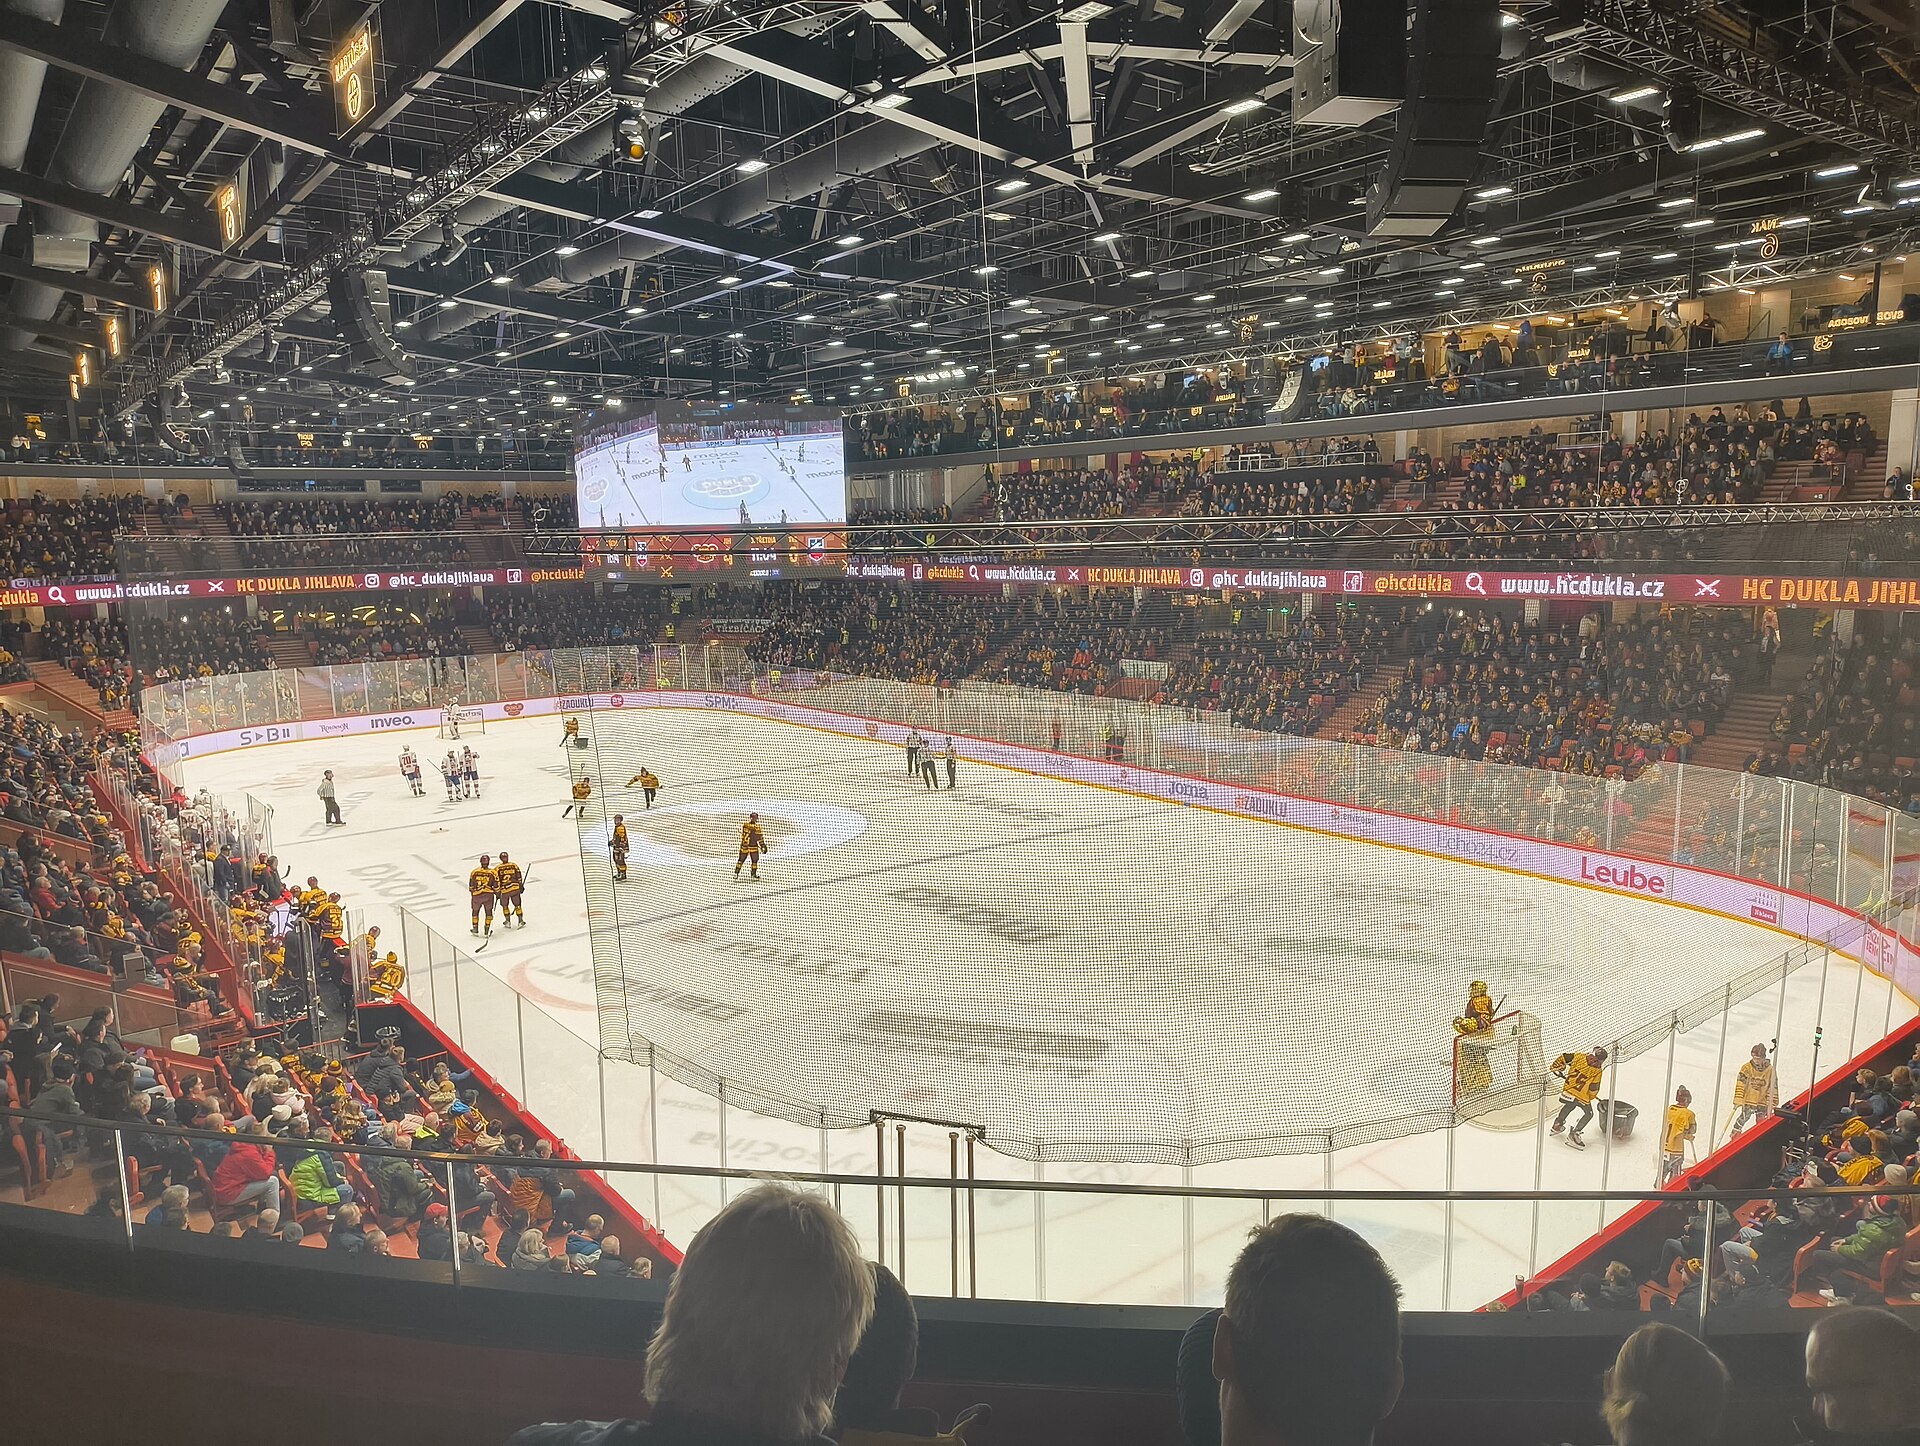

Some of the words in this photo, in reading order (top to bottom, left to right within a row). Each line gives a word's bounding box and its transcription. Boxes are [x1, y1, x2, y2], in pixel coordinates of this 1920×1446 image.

[236, 579, 254, 592] HC
[258, 577, 300, 592] DUKLA
[305, 575, 355, 590] JIHLAVA
[389, 572, 494, 588] @hc_duklajihlava
[985, 566, 1056, 582] www.hcdukla.cz
[1087, 567, 1101, 583] HC
[1102, 568, 1136, 584] DUKLA
[1138, 569, 1181, 586] JIHLAVA
[1212, 570, 1328, 590] @hc_duklajihlava
[75, 582, 190, 601] www.hcdukla.cz
[1374, 575, 1452, 593] @hcdukla
[1500, 573, 1665, 598] www.hcdukla.cz
[1742, 579, 1774, 599] HC
[1779, 579, 1861, 602] DUKLA
[1867, 581, 1920, 605] JIHL
[1581, 855, 1665, 894] Leube
